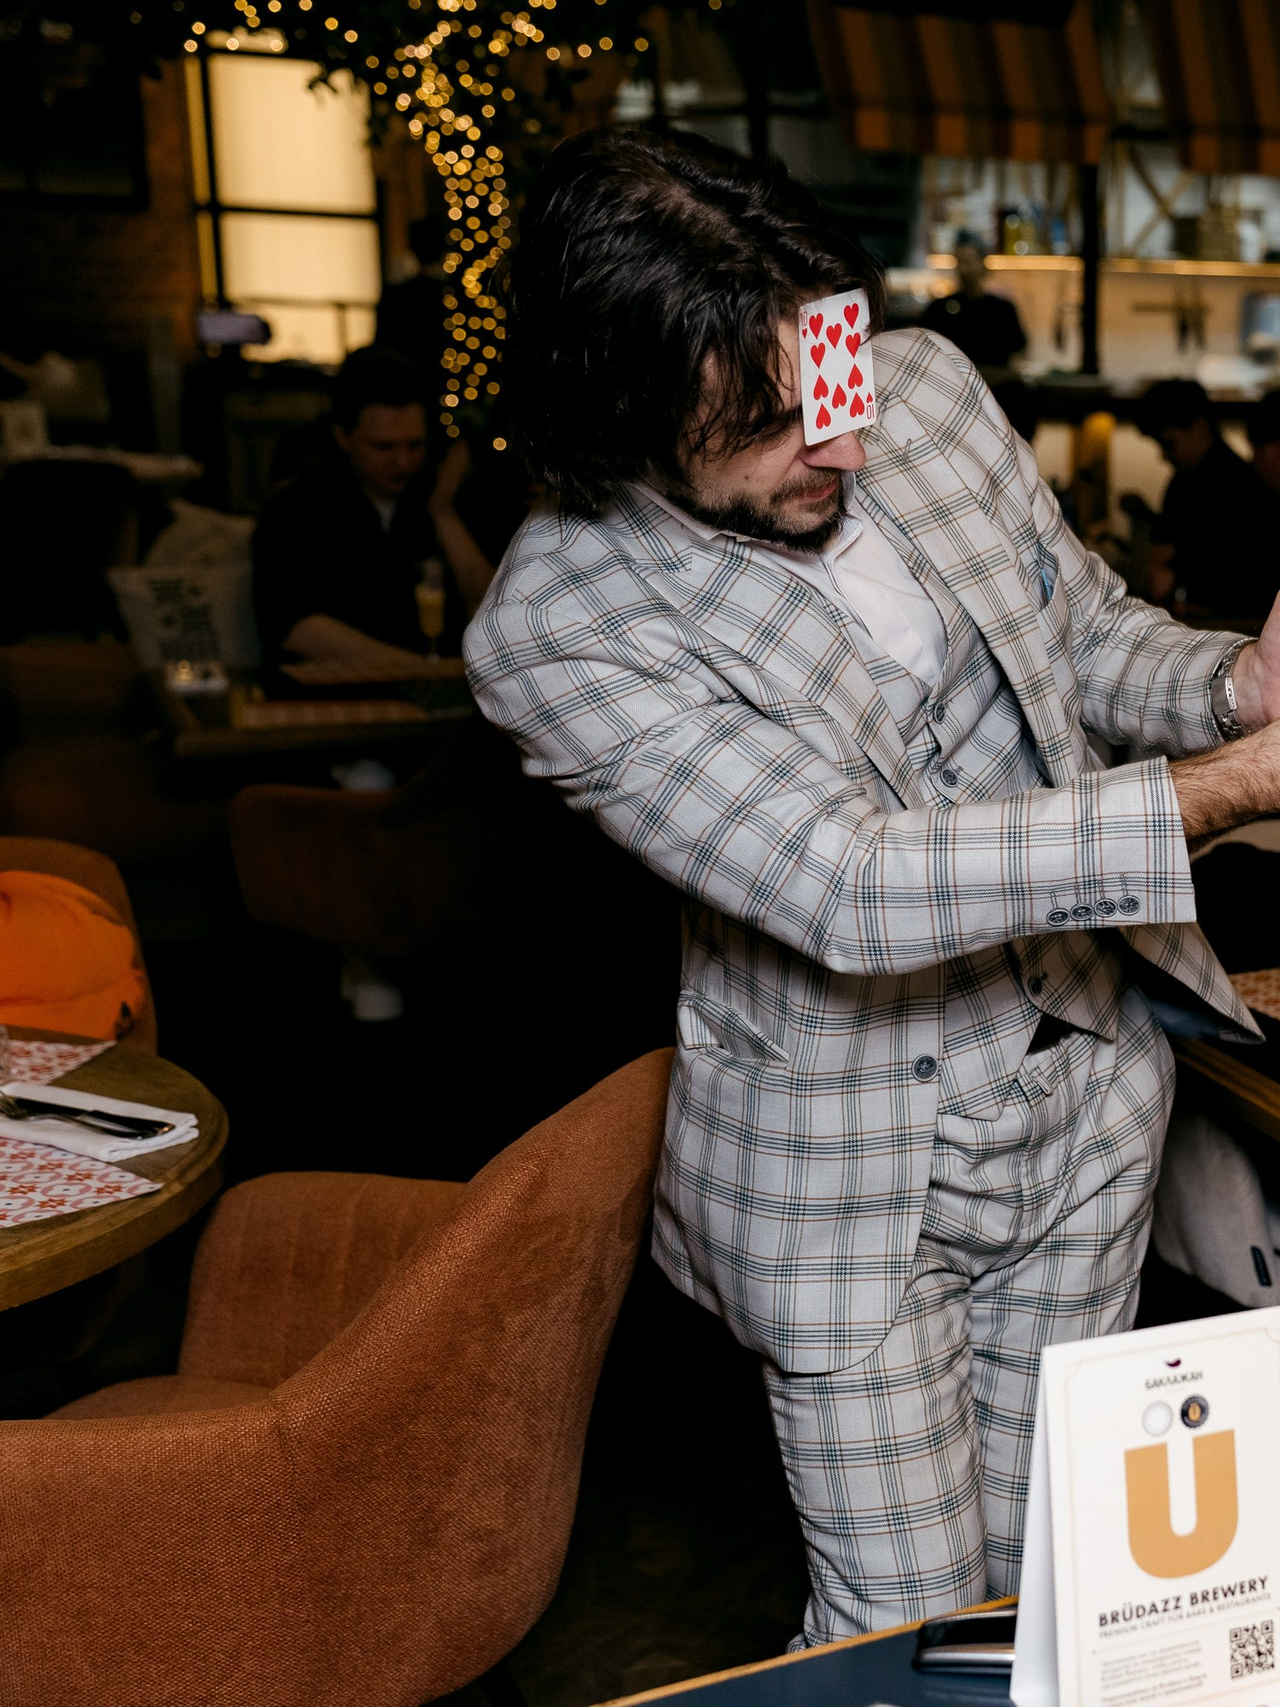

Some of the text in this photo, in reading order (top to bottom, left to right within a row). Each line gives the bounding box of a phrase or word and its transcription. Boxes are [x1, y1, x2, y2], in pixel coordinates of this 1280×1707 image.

[866, 404, 875, 420] 10
[1099, 1575, 1269, 1627] BRÜDAZZ BREWERY
[1099, 1625, 1138, 1638] PREMIUM
[1140, 1617, 1165, 1629] CRAFT
[1167, 1612, 1184, 1623] FOR
